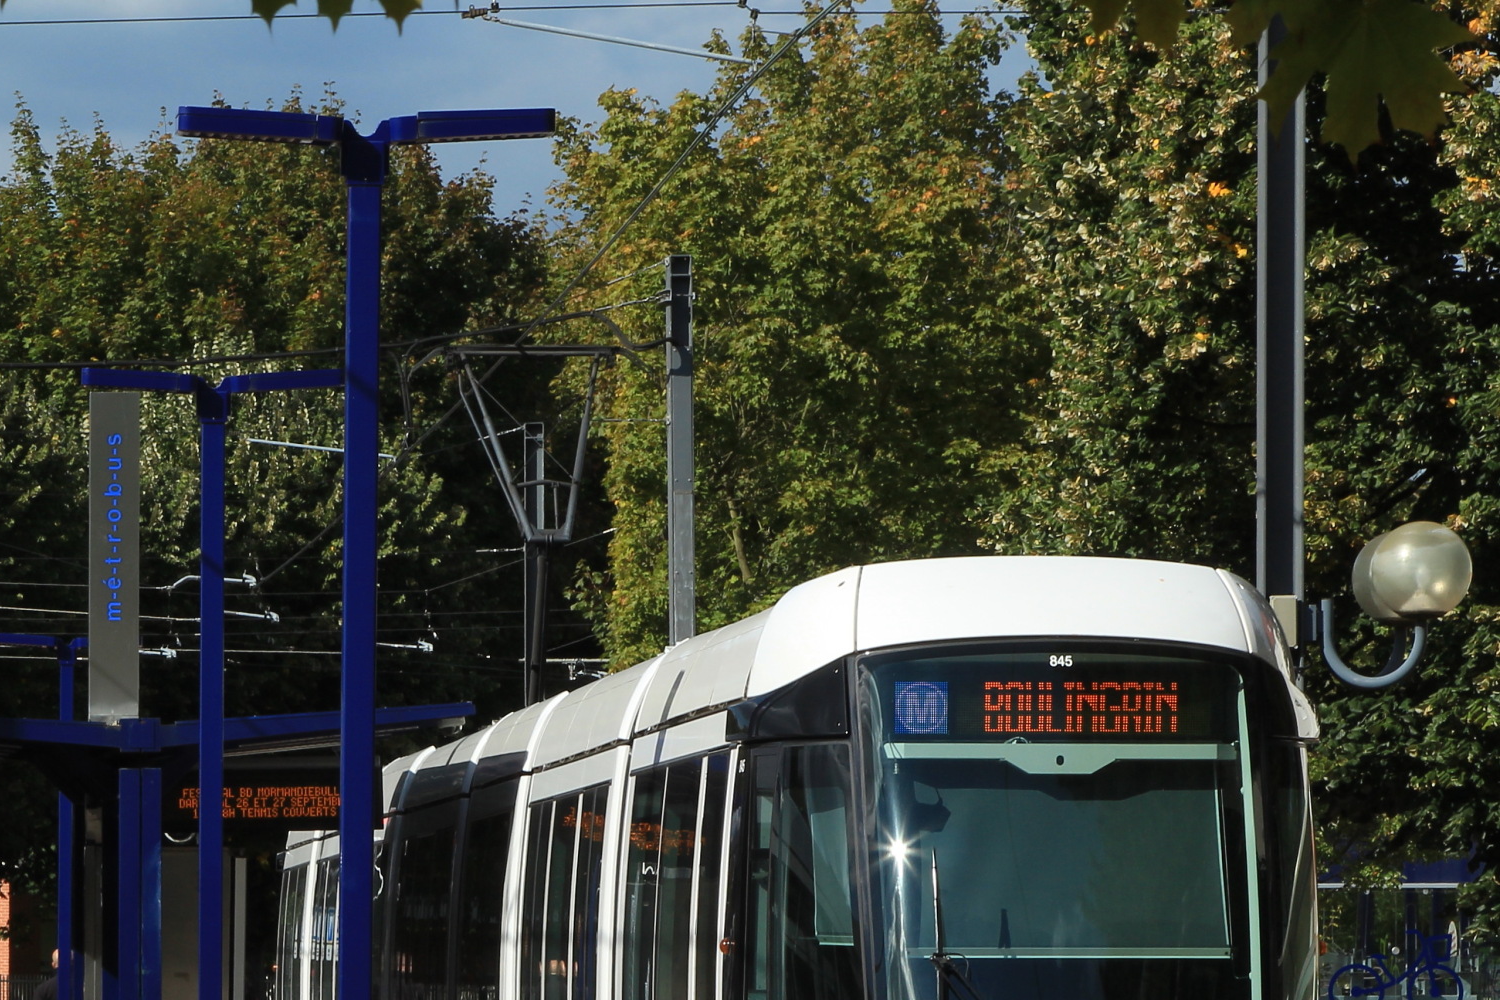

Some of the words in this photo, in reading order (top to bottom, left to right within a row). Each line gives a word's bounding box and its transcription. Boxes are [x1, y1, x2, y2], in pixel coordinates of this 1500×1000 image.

[1049, 655, 1073, 667] 845
[984, 682, 1178, 732] BOULINGRIN
[240, 787, 252, 797] BD
[257, 786, 340, 797] NORMANDIEBULL
[236, 798, 249, 808] 26
[253, 798, 266, 808] ET
[272, 797, 285, 807] 27
[290, 796, 341, 807] SEPTEMB
[242, 807, 278, 818] TENNIS
[283, 806, 337, 817] COUVERTS
